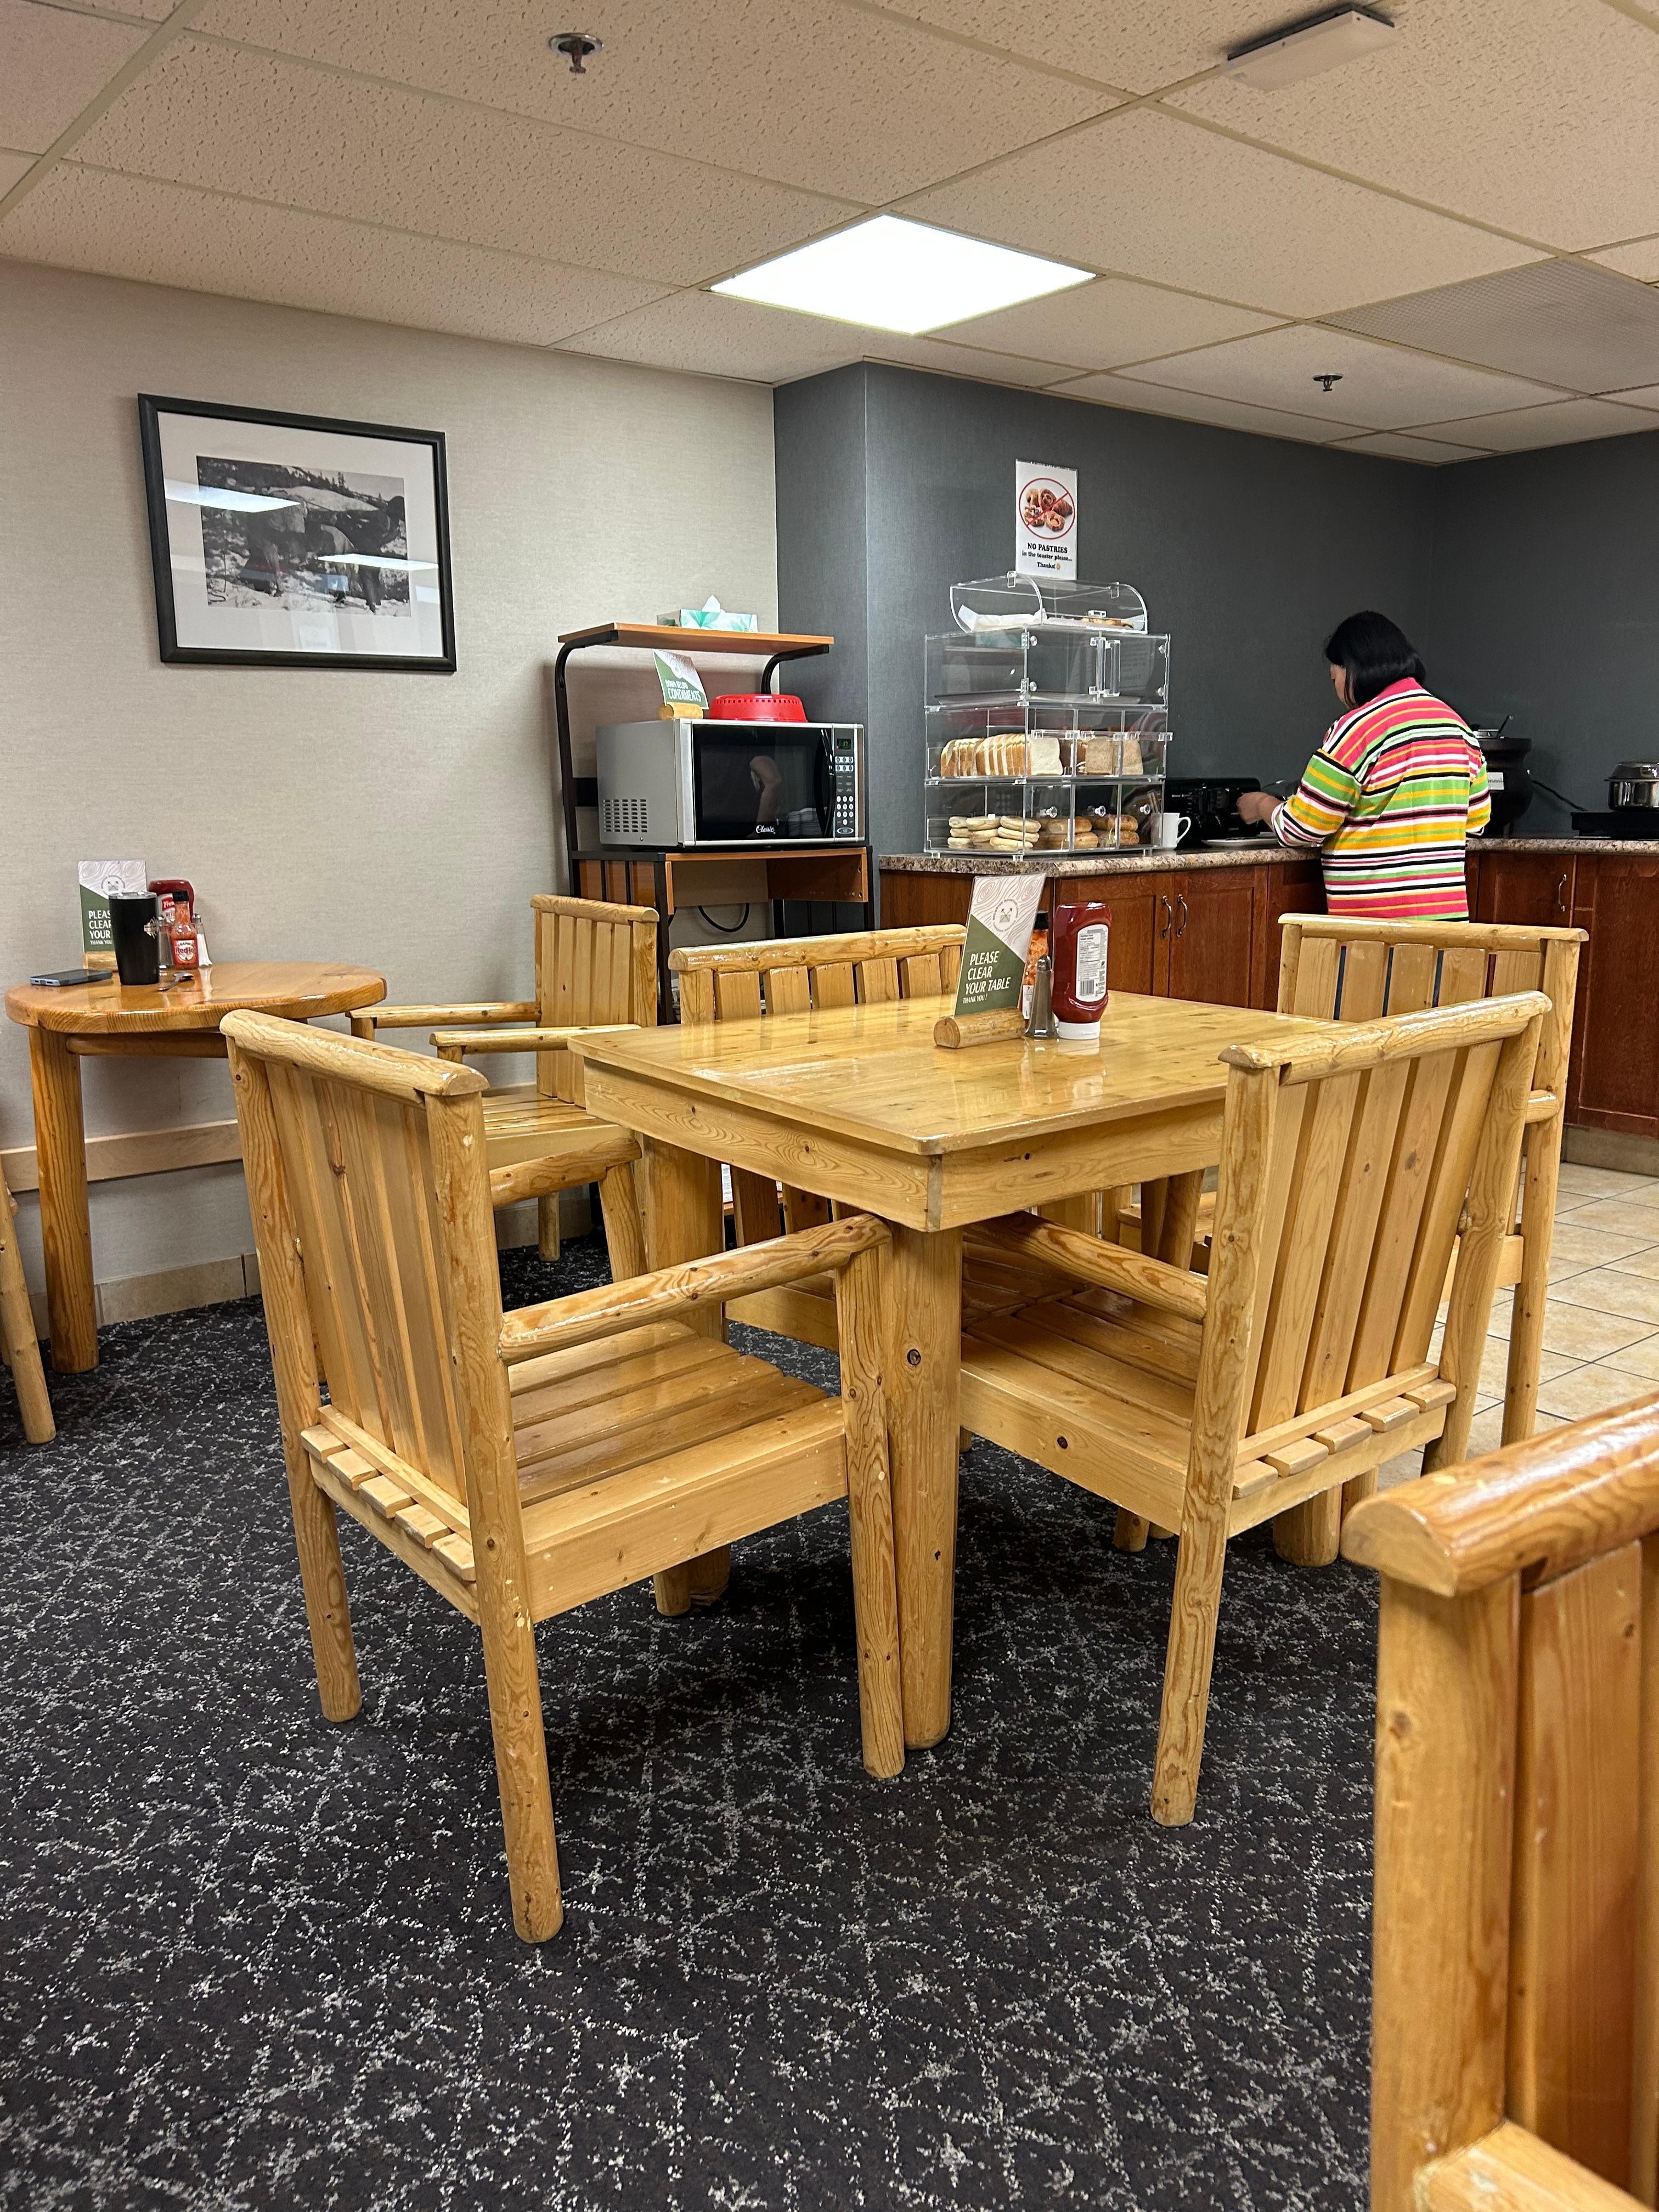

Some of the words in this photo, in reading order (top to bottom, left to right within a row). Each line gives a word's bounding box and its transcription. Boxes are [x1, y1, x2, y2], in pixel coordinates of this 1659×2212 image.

[1038, 544, 1068, 554] PASTRIES
[1037, 561, 1056, 569] Thanks!
[667, 687, 702, 702] CONDIMENTS
[163, 900, 175, 909] Fren
[88, 910, 111, 919] PLEAS
[89, 929, 111, 939] YOUR
[969, 951, 1000, 966] PLEASE
[967, 966, 993, 981] CLEAR
[965, 980, 986, 995] YOUR
[988, 977, 1011, 991] TABLE
[963, 996, 976, 1004] THANK
